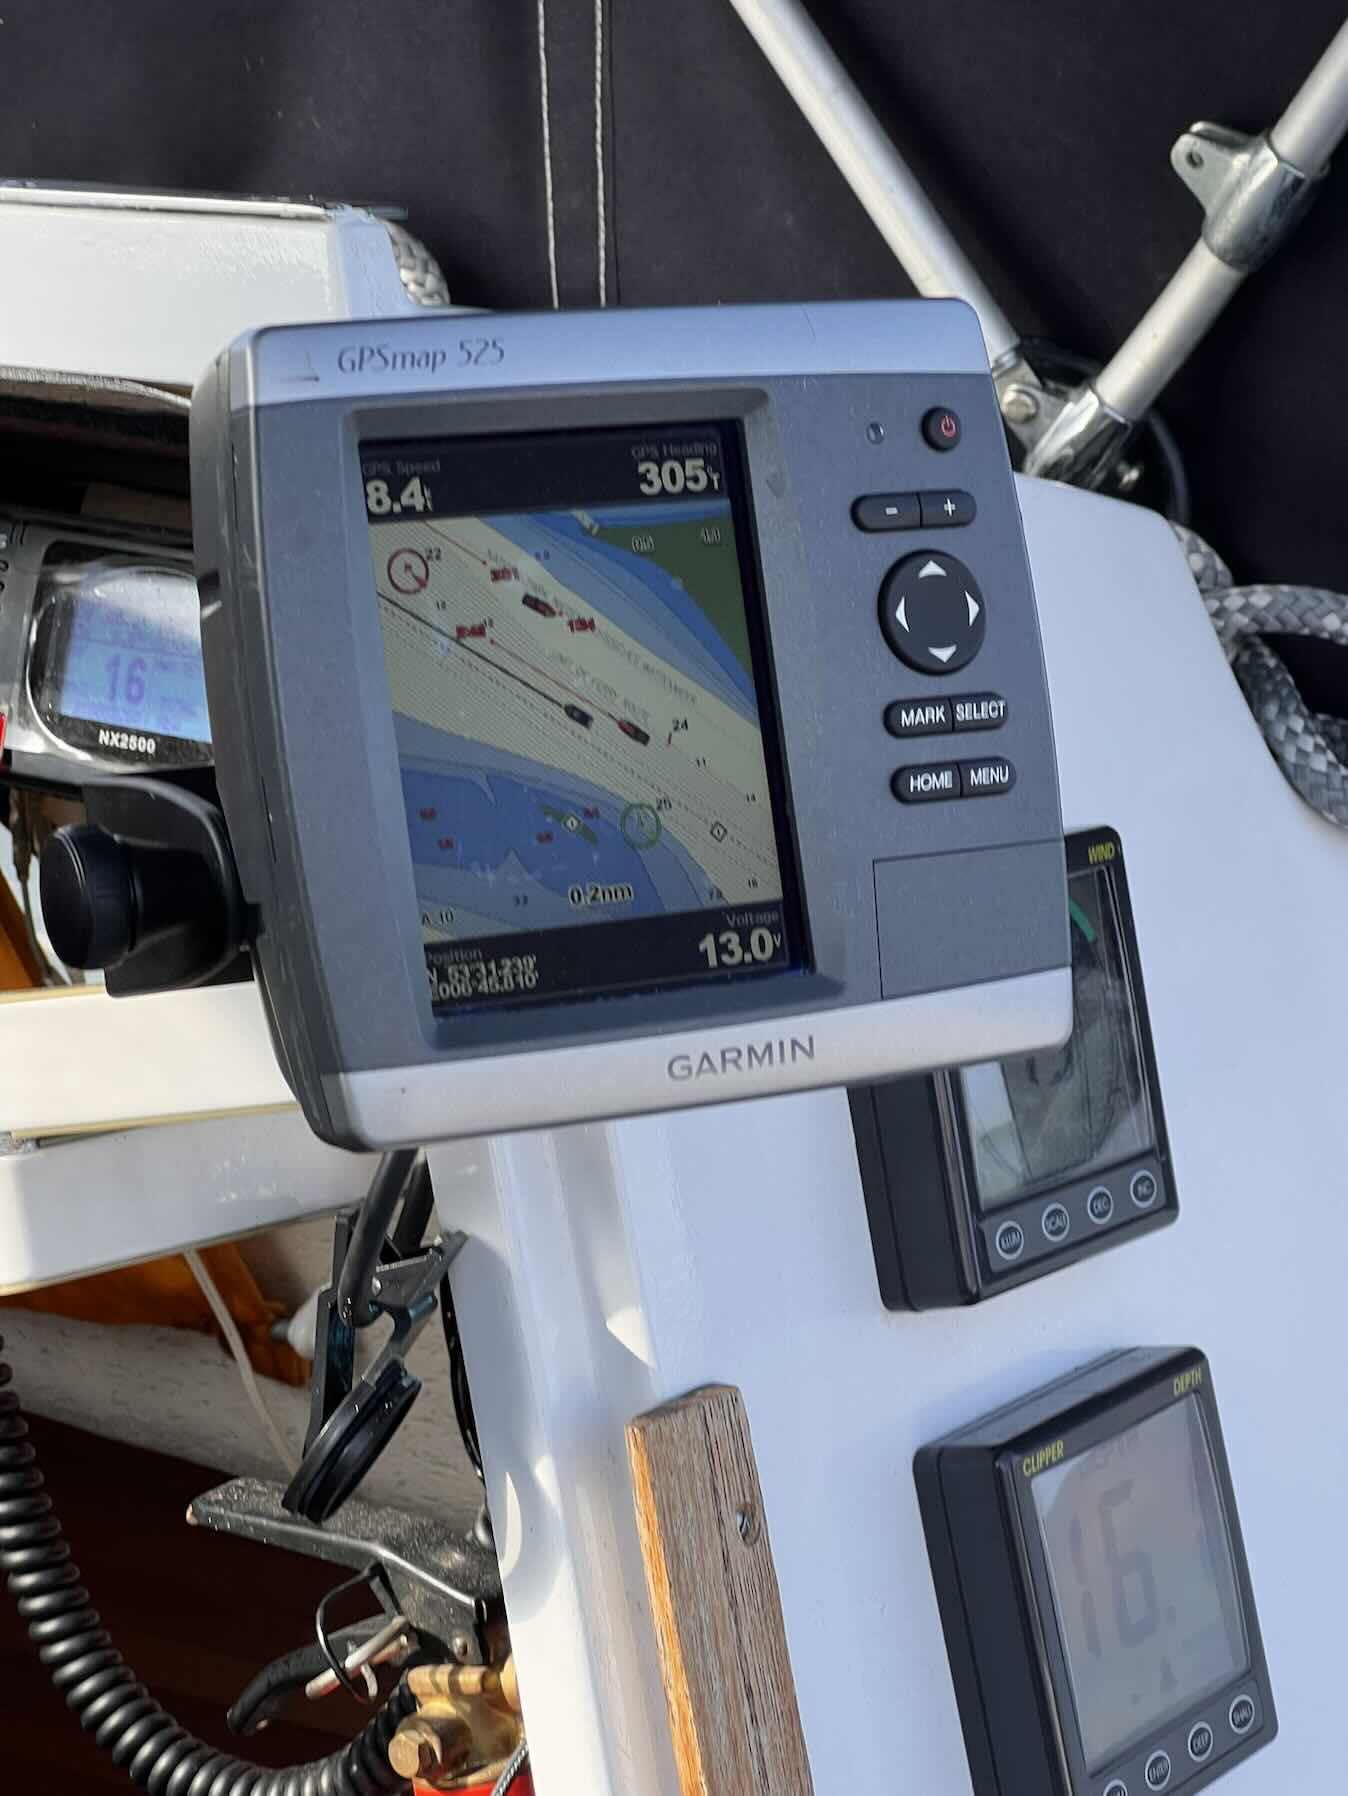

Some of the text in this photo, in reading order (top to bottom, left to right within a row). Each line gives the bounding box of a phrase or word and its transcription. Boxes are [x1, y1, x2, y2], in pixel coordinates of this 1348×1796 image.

[337, 338, 505, 375] GPSmap 525
[901, 705, 946, 728] MARK
[956, 701, 1006, 722] SELECT
[98, 728, 156, 755] NX2500
[910, 771, 953, 793] HOME
[970, 765, 1009, 786] MENU
[1088, 841, 1115, 864] WIND
[725, 910, 780, 929] Voltage
[668, 1035, 815, 1081] GARMIN
[1173, 1367, 1202, 1397] DEPTH
[1023, 1440, 1064, 1477] CLIPPER
